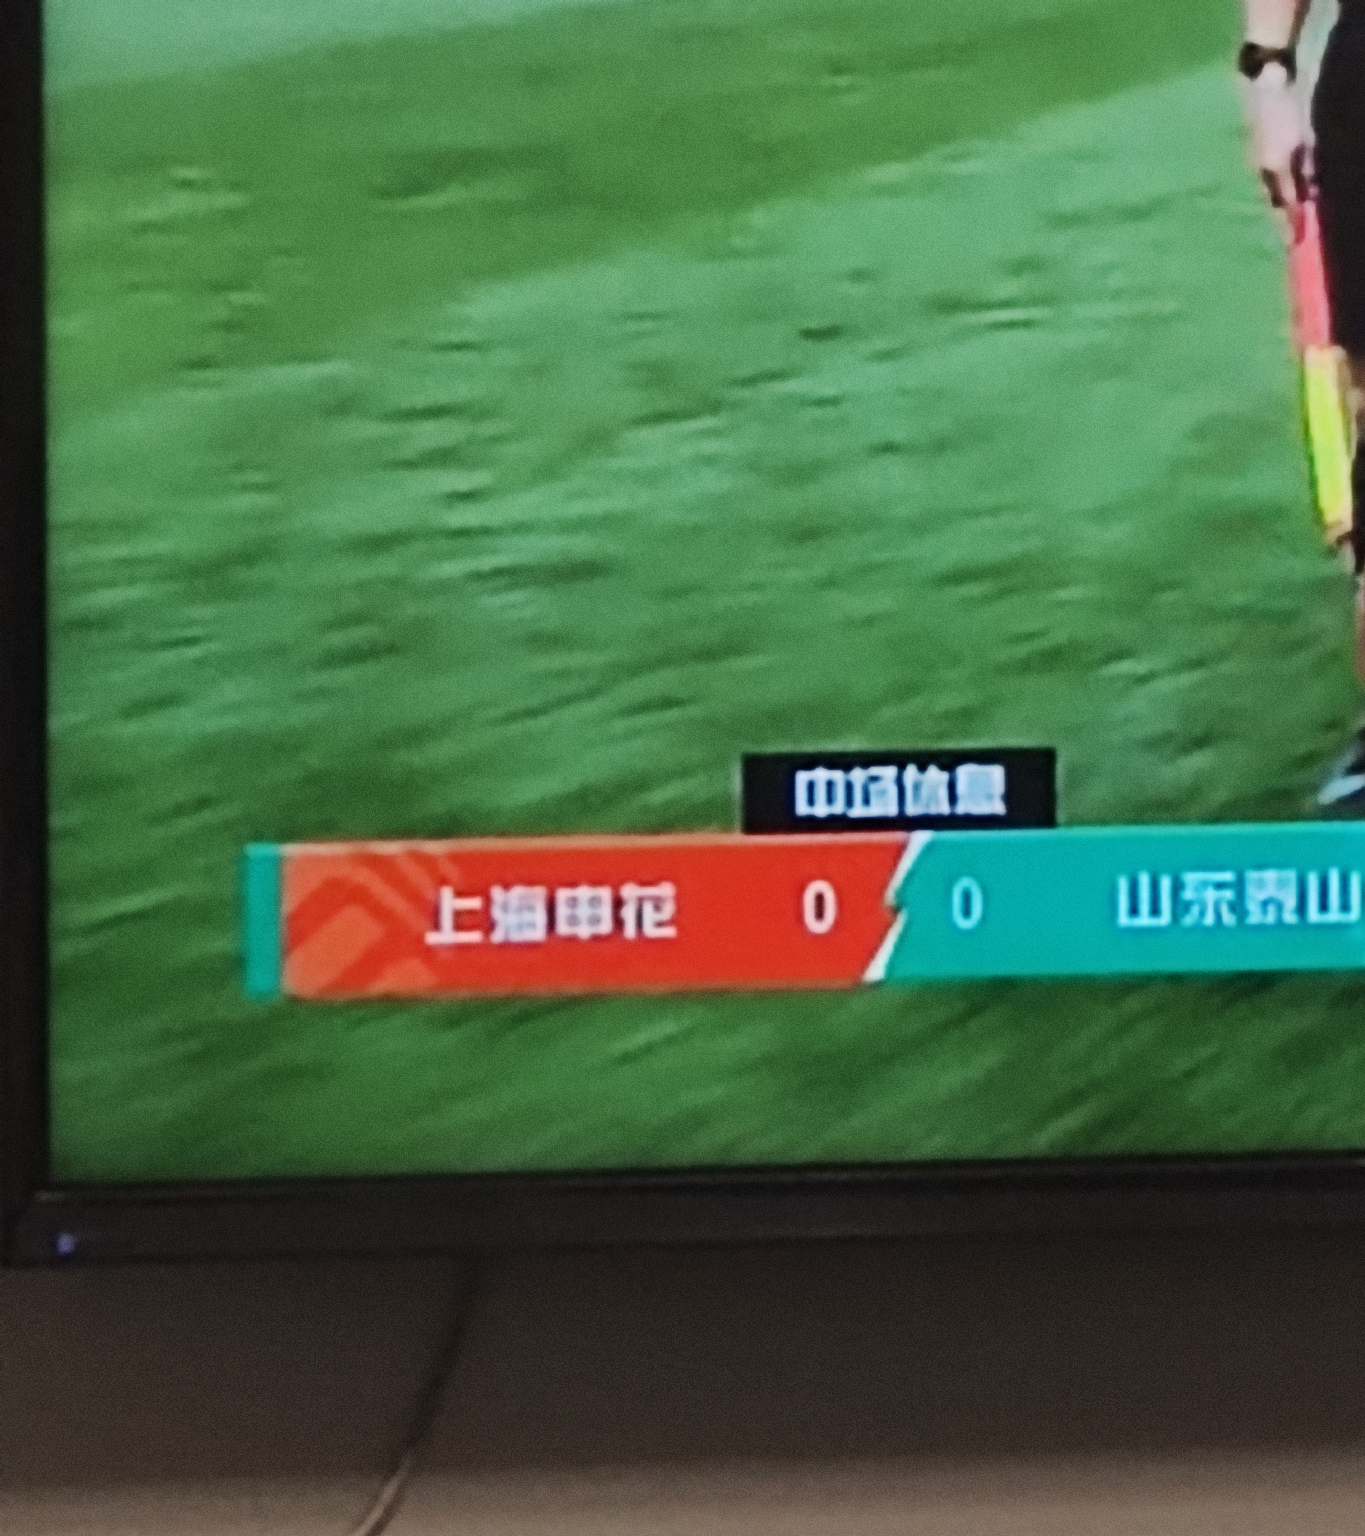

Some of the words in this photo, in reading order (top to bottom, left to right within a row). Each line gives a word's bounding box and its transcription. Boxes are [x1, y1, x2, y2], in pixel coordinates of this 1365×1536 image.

[423, 879, 680, 946] 上海申花
[802, 878, 839, 935] 0
[951, 874, 985, 932] 0
[1115, 865, 1363, 928] 山东泰山
